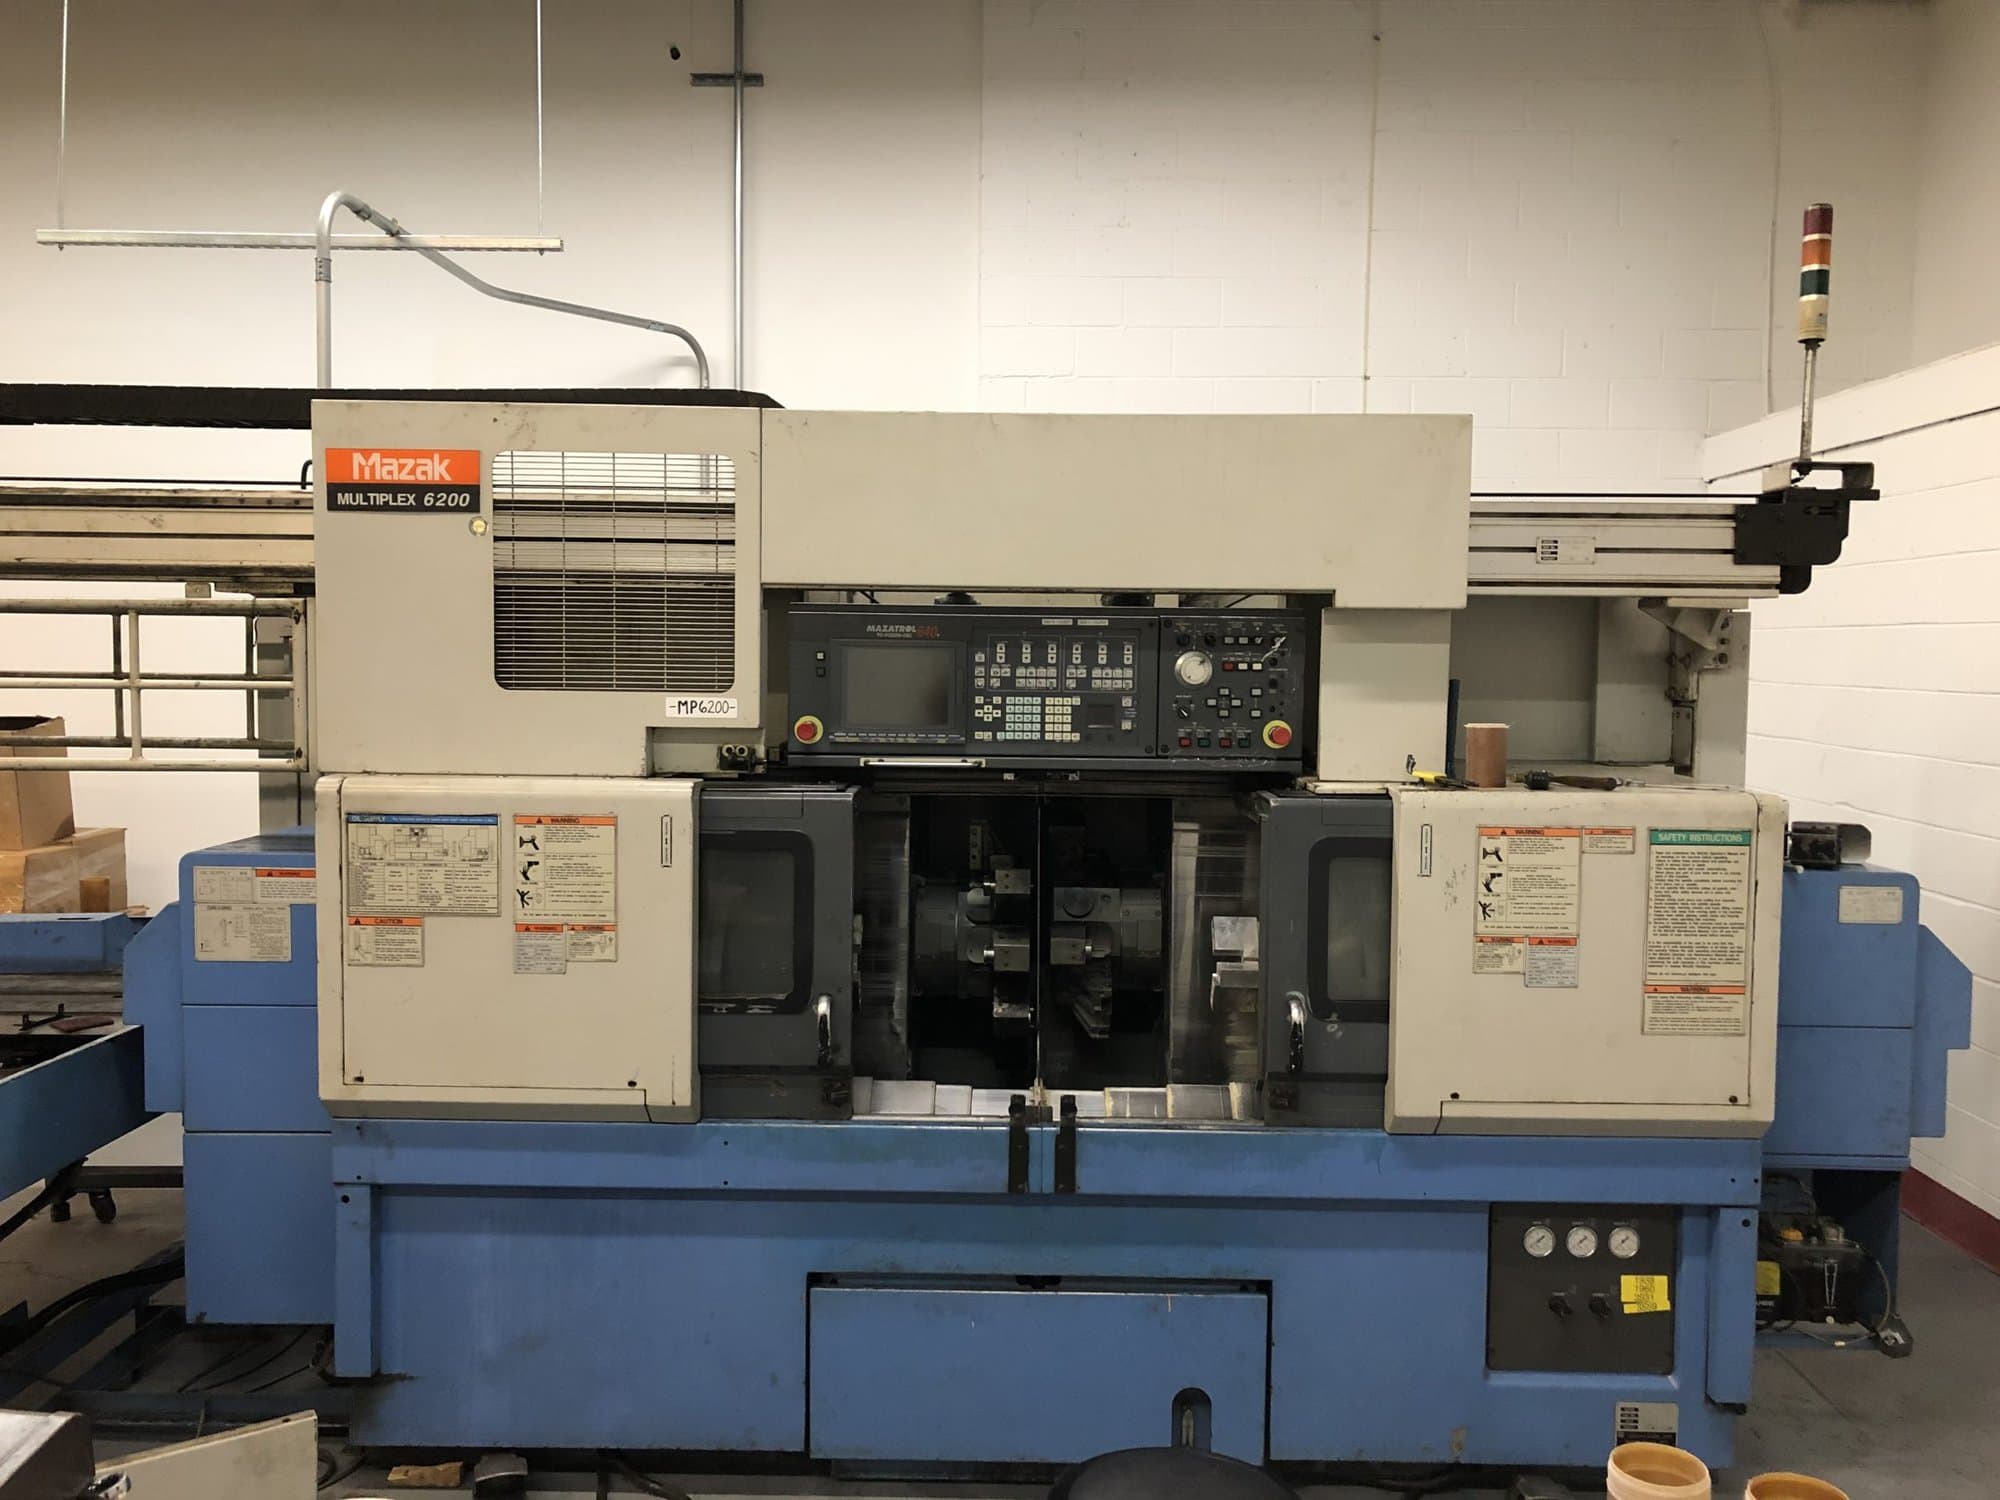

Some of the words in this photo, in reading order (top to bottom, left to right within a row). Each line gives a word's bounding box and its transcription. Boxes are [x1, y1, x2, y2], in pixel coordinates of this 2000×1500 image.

[352, 452, 452, 481] Mazak
[337, 492, 416, 506] MULTIPLEX
[423, 492, 471, 507] 6200
[866, 624, 917, 633] MAZATROL
[1658, 832, 1686, 842] SAFETY
[1689, 833, 1743, 843] INSTRUCTIONS
